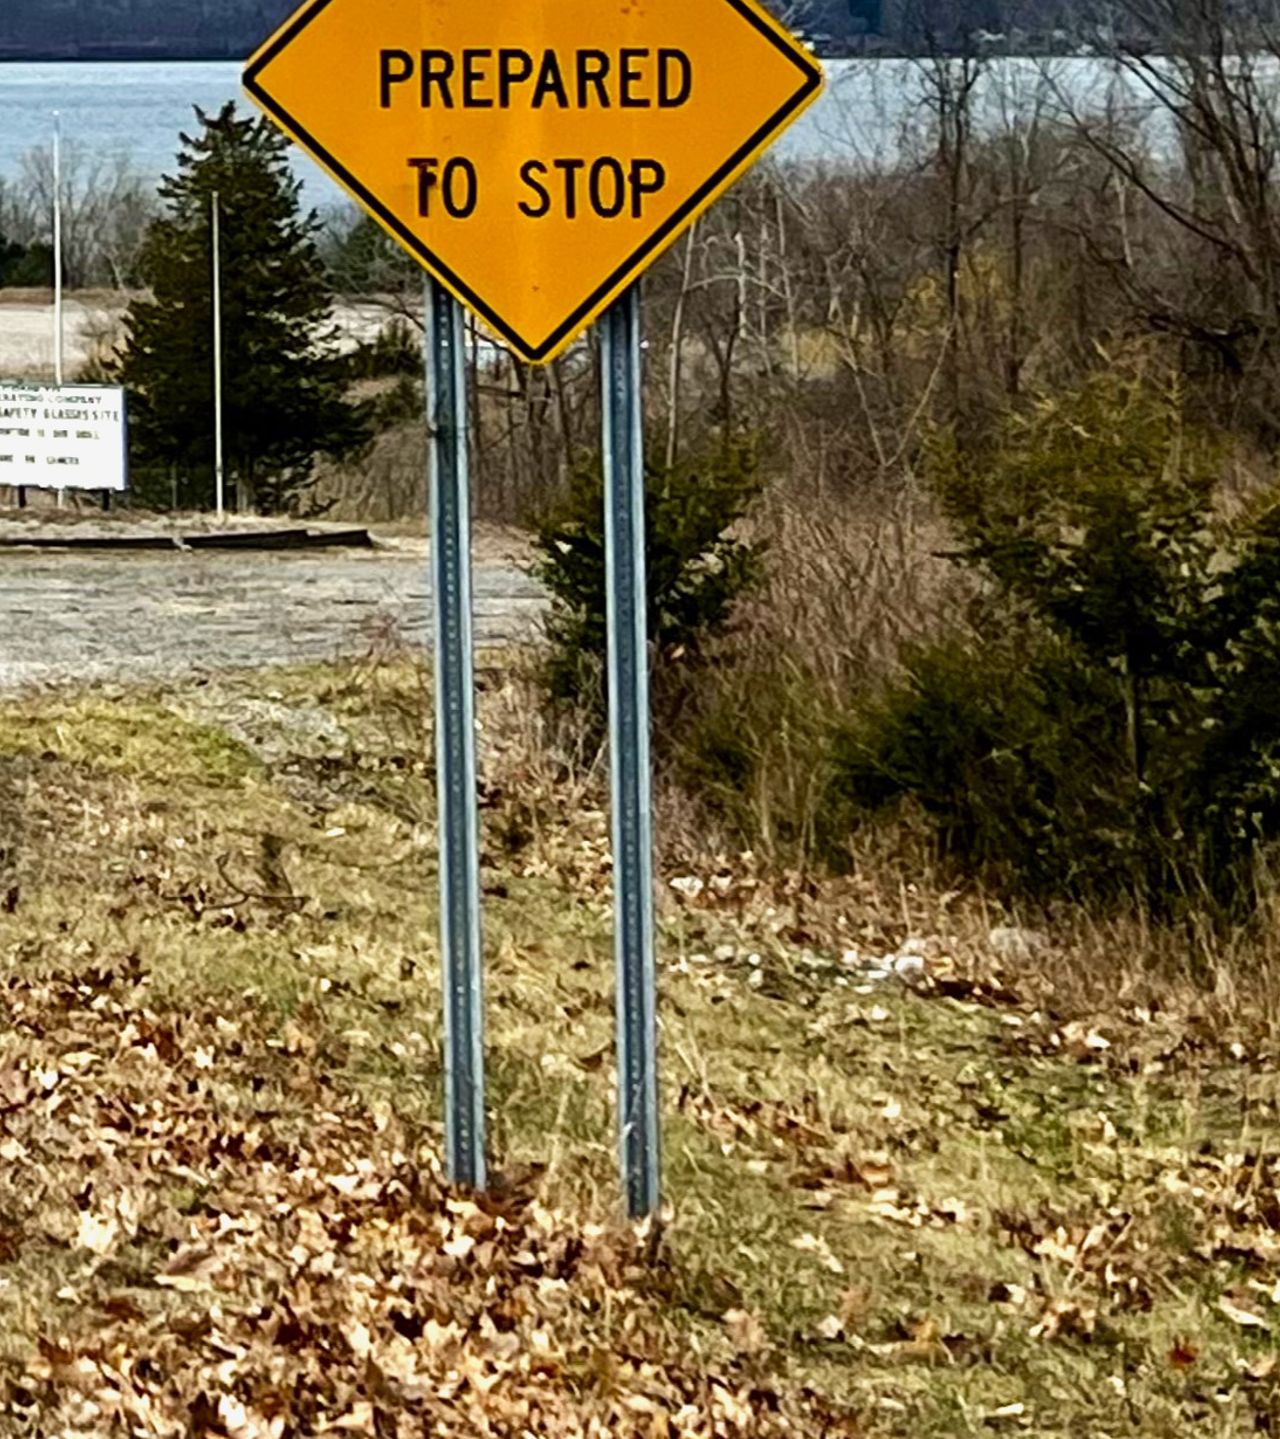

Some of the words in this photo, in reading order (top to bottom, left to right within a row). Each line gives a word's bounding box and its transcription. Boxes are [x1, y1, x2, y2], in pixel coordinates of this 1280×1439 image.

[379, 48, 693, 109] PREPARED
[407, 156, 478, 219] TO
[517, 156, 666, 220] STOP
